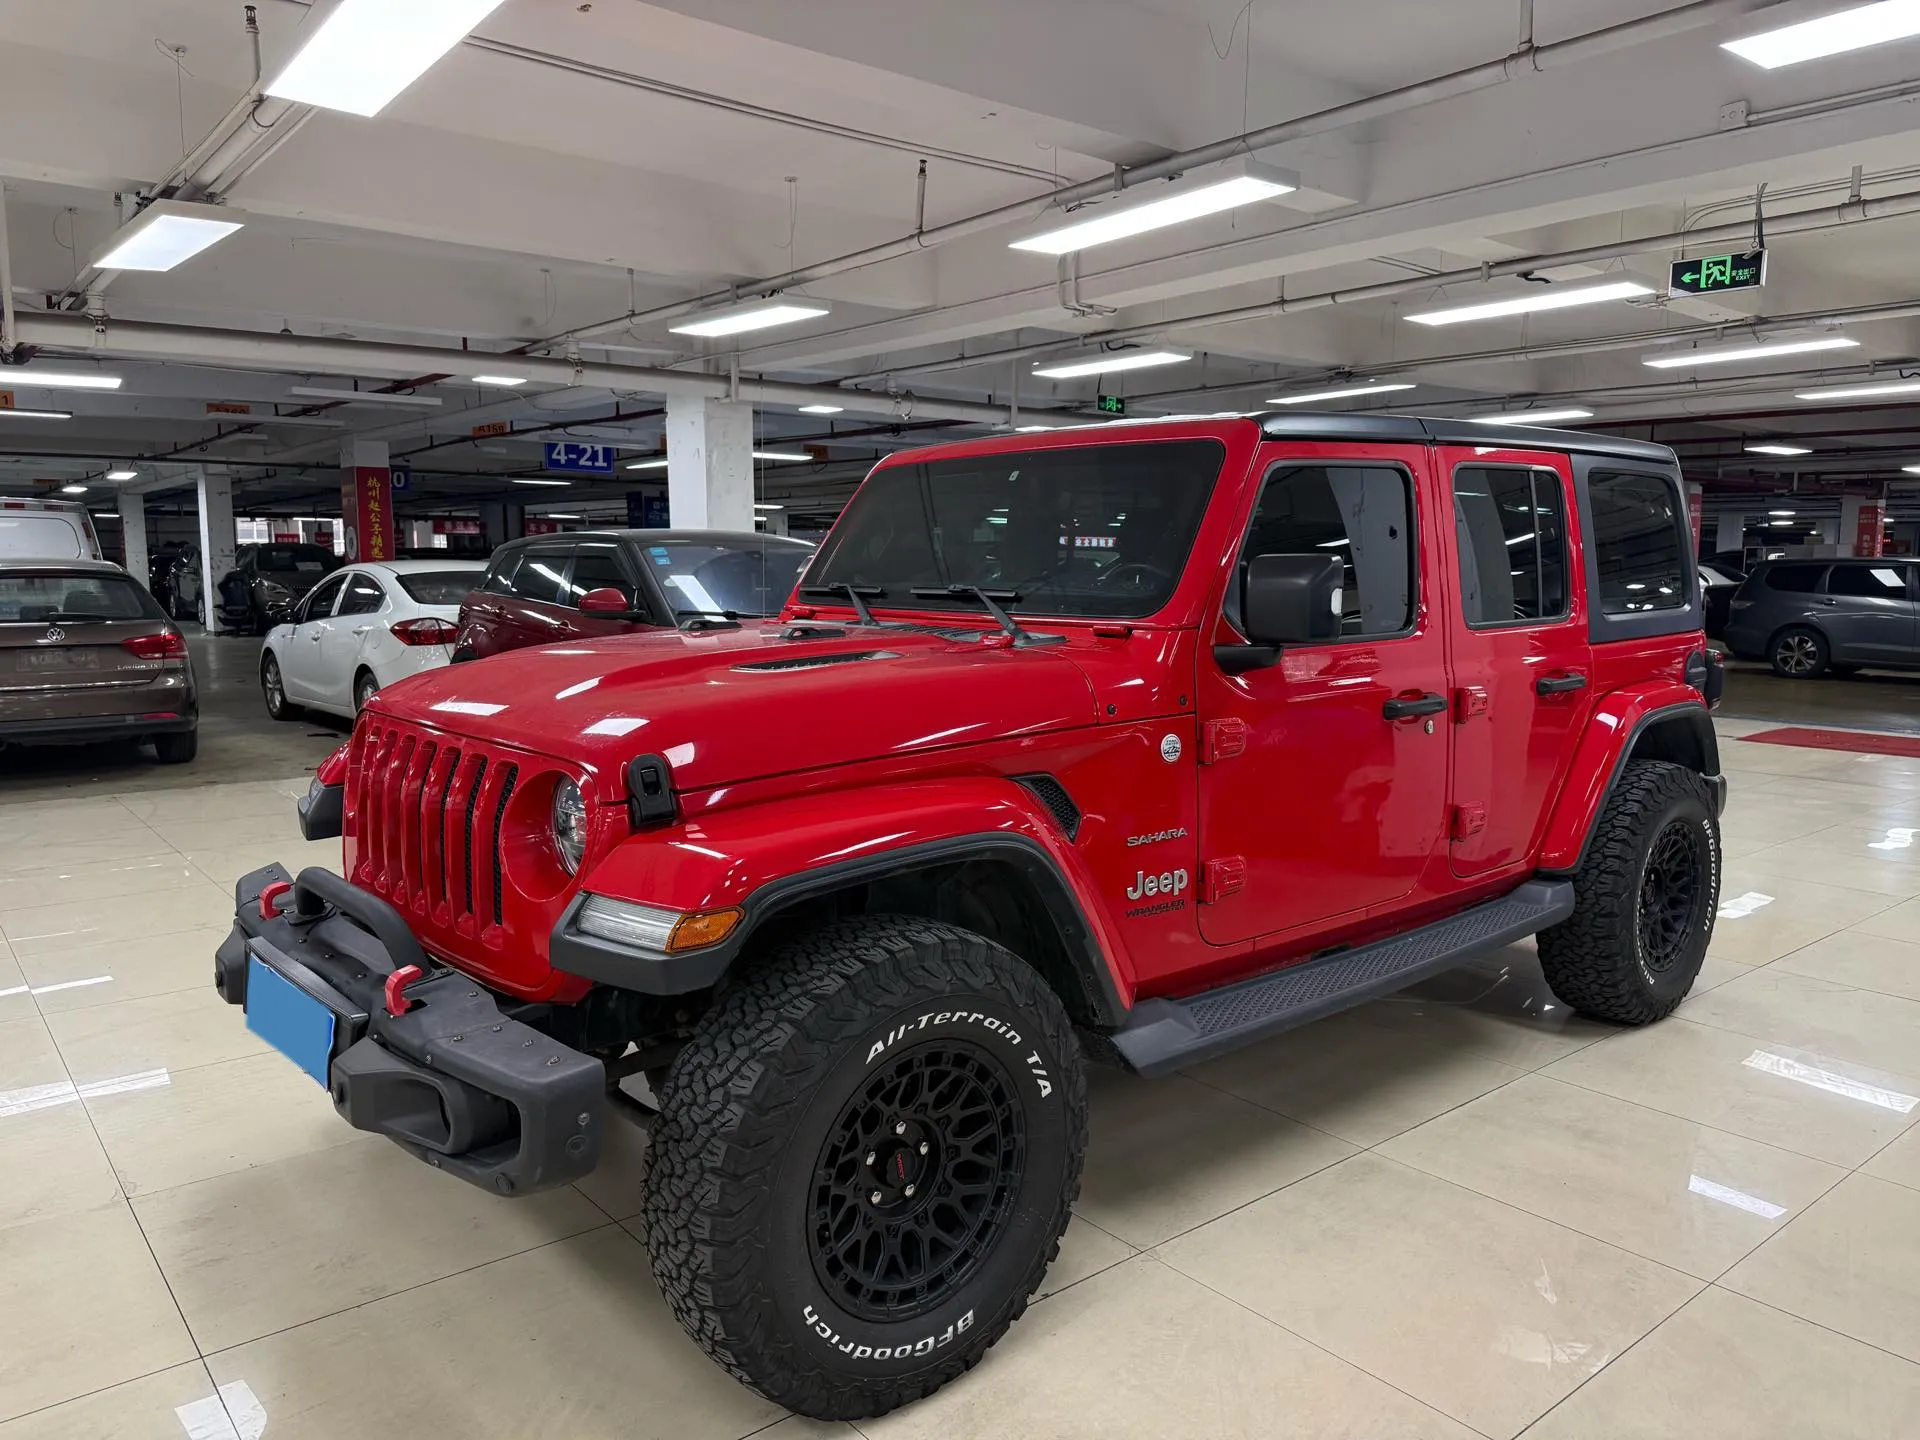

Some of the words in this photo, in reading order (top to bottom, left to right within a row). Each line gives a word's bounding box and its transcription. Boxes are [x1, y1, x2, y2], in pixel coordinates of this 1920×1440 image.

[1731, 267, 1756, 276] 安全出口
[551, 442, 608, 467] 4-21
[1127, 827, 1188, 847] SAHARA
[1127, 868, 1188, 900] Jeep
[1702, 819, 1717, 932] BFGoodrich
[1126, 899, 1185, 917] WRANGLER
[864, 1011, 1022, 1065] All-Terrain
[1026, 1049, 1053, 1099] T/A
[803, 1304, 975, 1361] BFGoodrich
